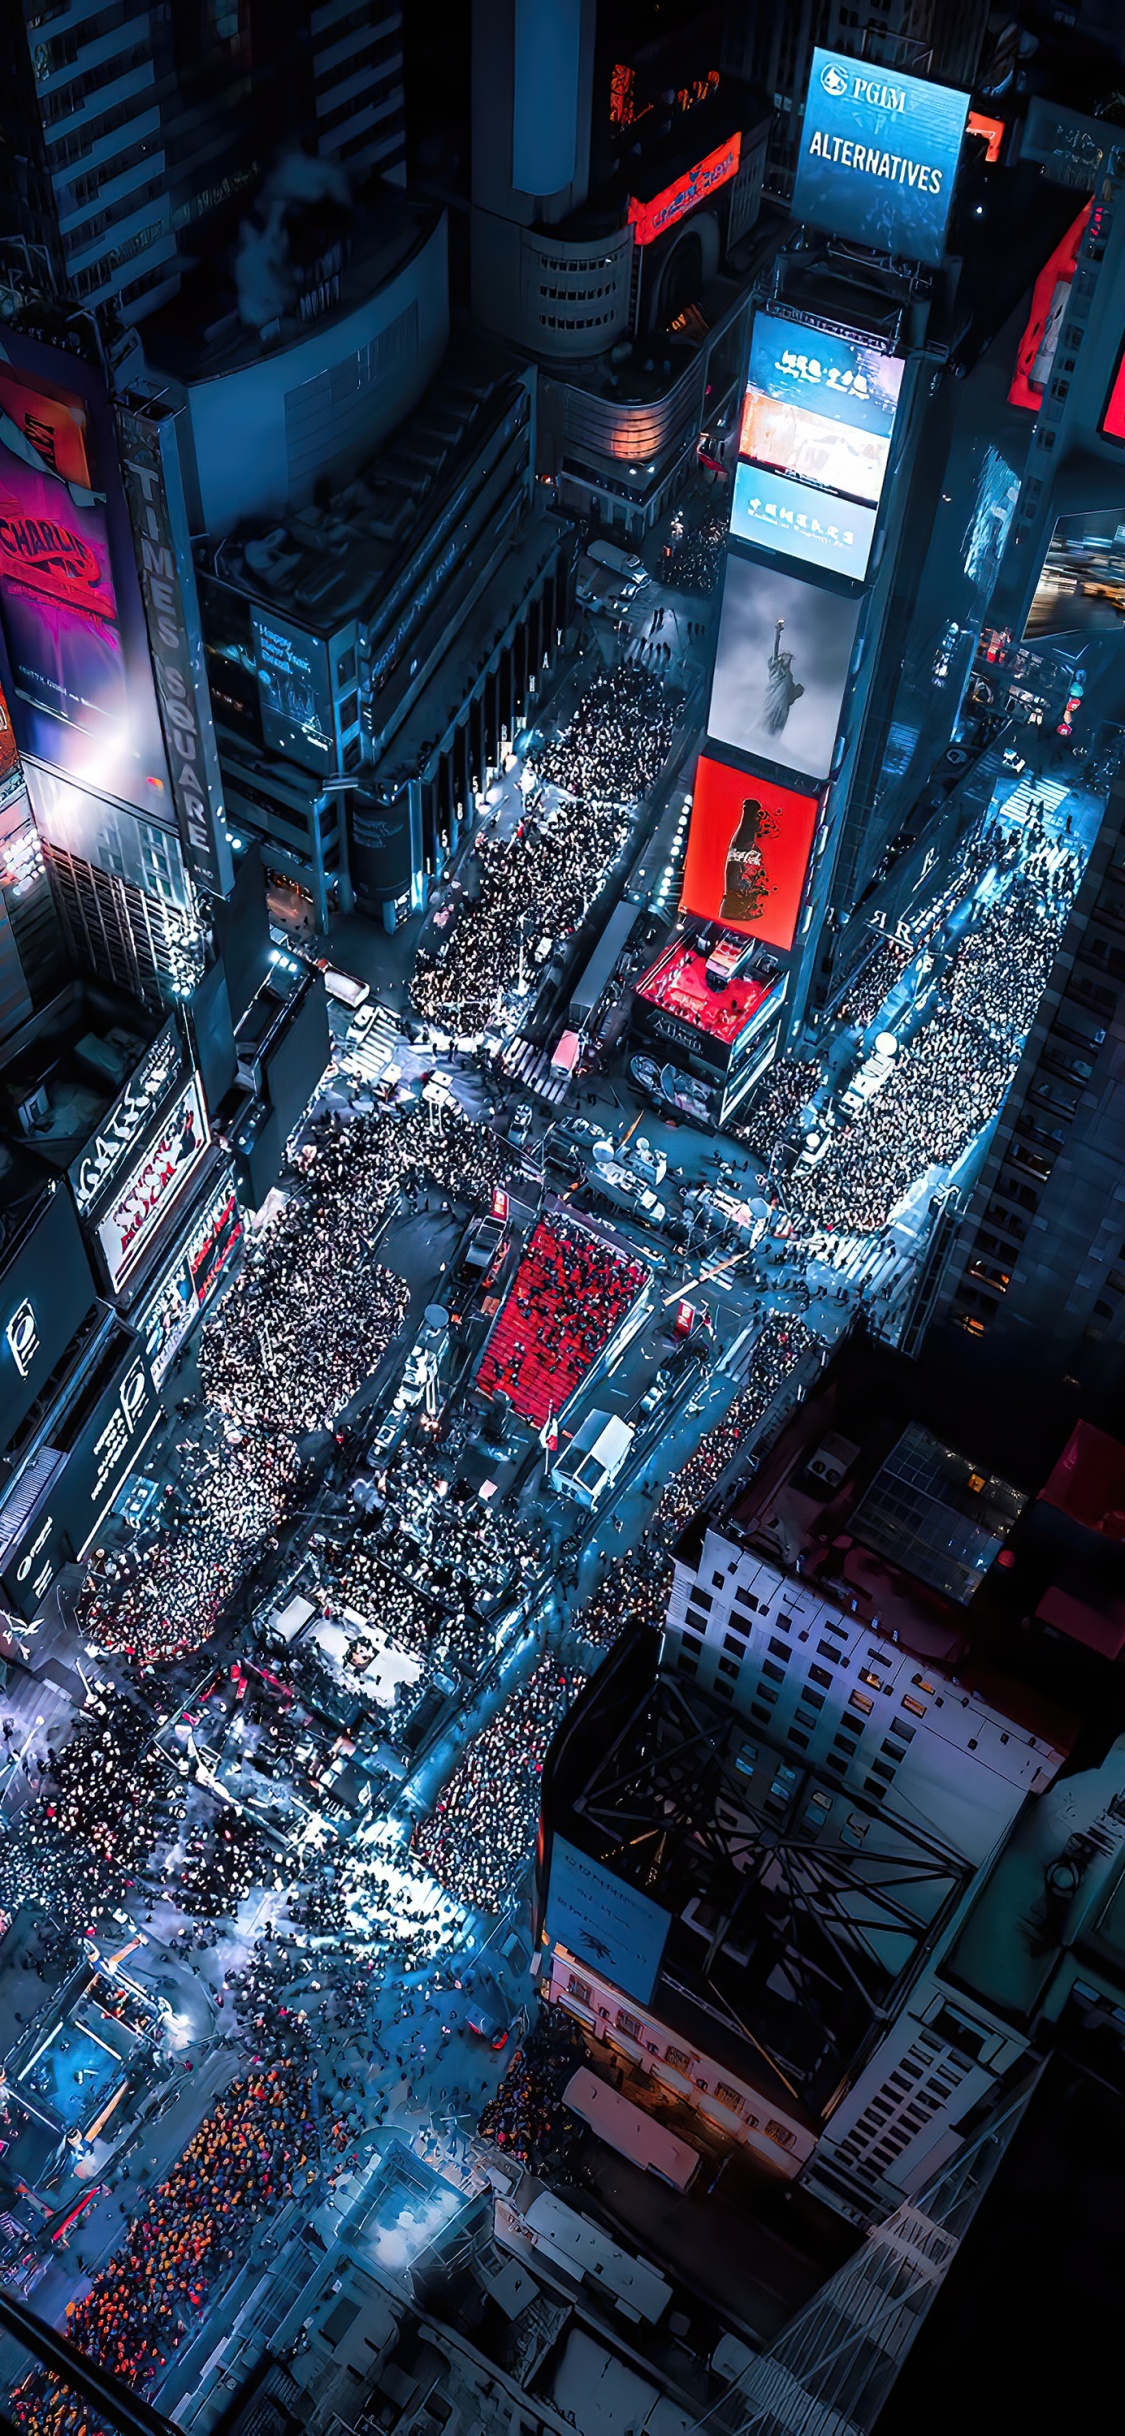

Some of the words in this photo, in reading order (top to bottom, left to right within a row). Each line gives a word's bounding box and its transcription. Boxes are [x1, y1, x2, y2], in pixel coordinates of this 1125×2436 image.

[853, 77, 906, 113] PGIM
[809, 131, 943, 194] ALTERNATIVES
[124, 457, 180, 650] TIMES
[164, 666, 210, 853] SQUARE
